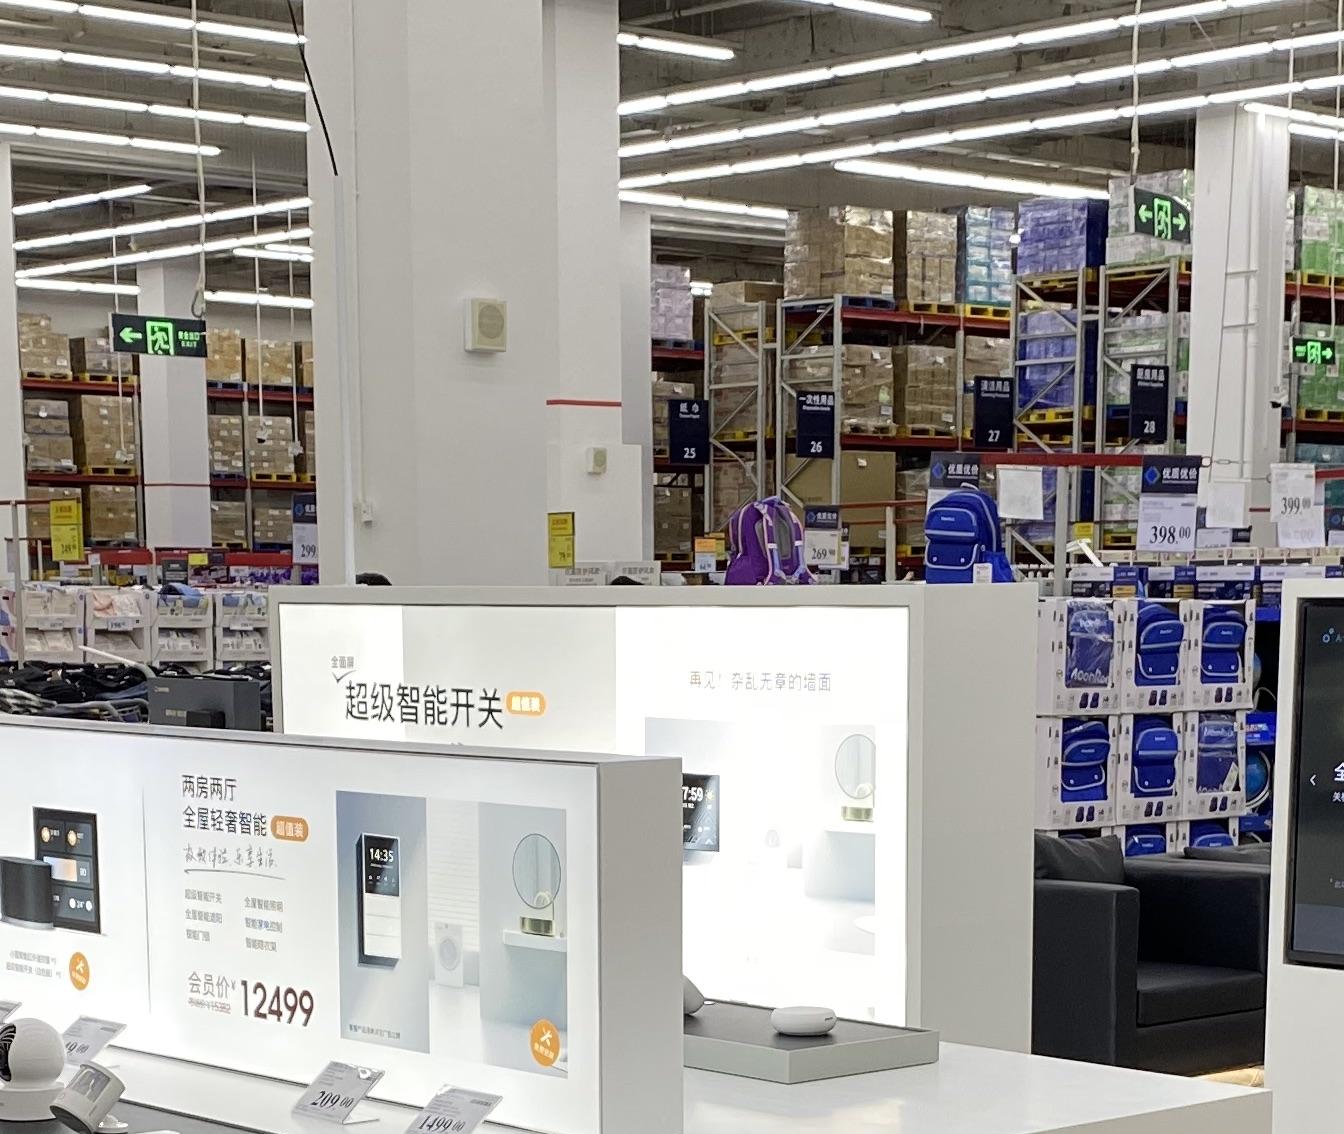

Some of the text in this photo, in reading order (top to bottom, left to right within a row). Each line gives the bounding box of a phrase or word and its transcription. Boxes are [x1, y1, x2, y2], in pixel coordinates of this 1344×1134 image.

[1143, 420, 1156, 434] 28
[988, 430, 1001, 442] 27
[683, 447, 696, 459] 25
[810, 440, 823, 453] 26
[1162, 467, 1198, 481] 优质优价
[1150, 525, 1191, 545] 398.00
[346, 680, 504, 729] 超级智能开关
[182, 774, 237, 801] 两房两厅
[183, 805, 267, 837] 全屋轻奢智能
[369, 847, 395, 863] 14:35
[240, 980, 315, 1028] 12499
